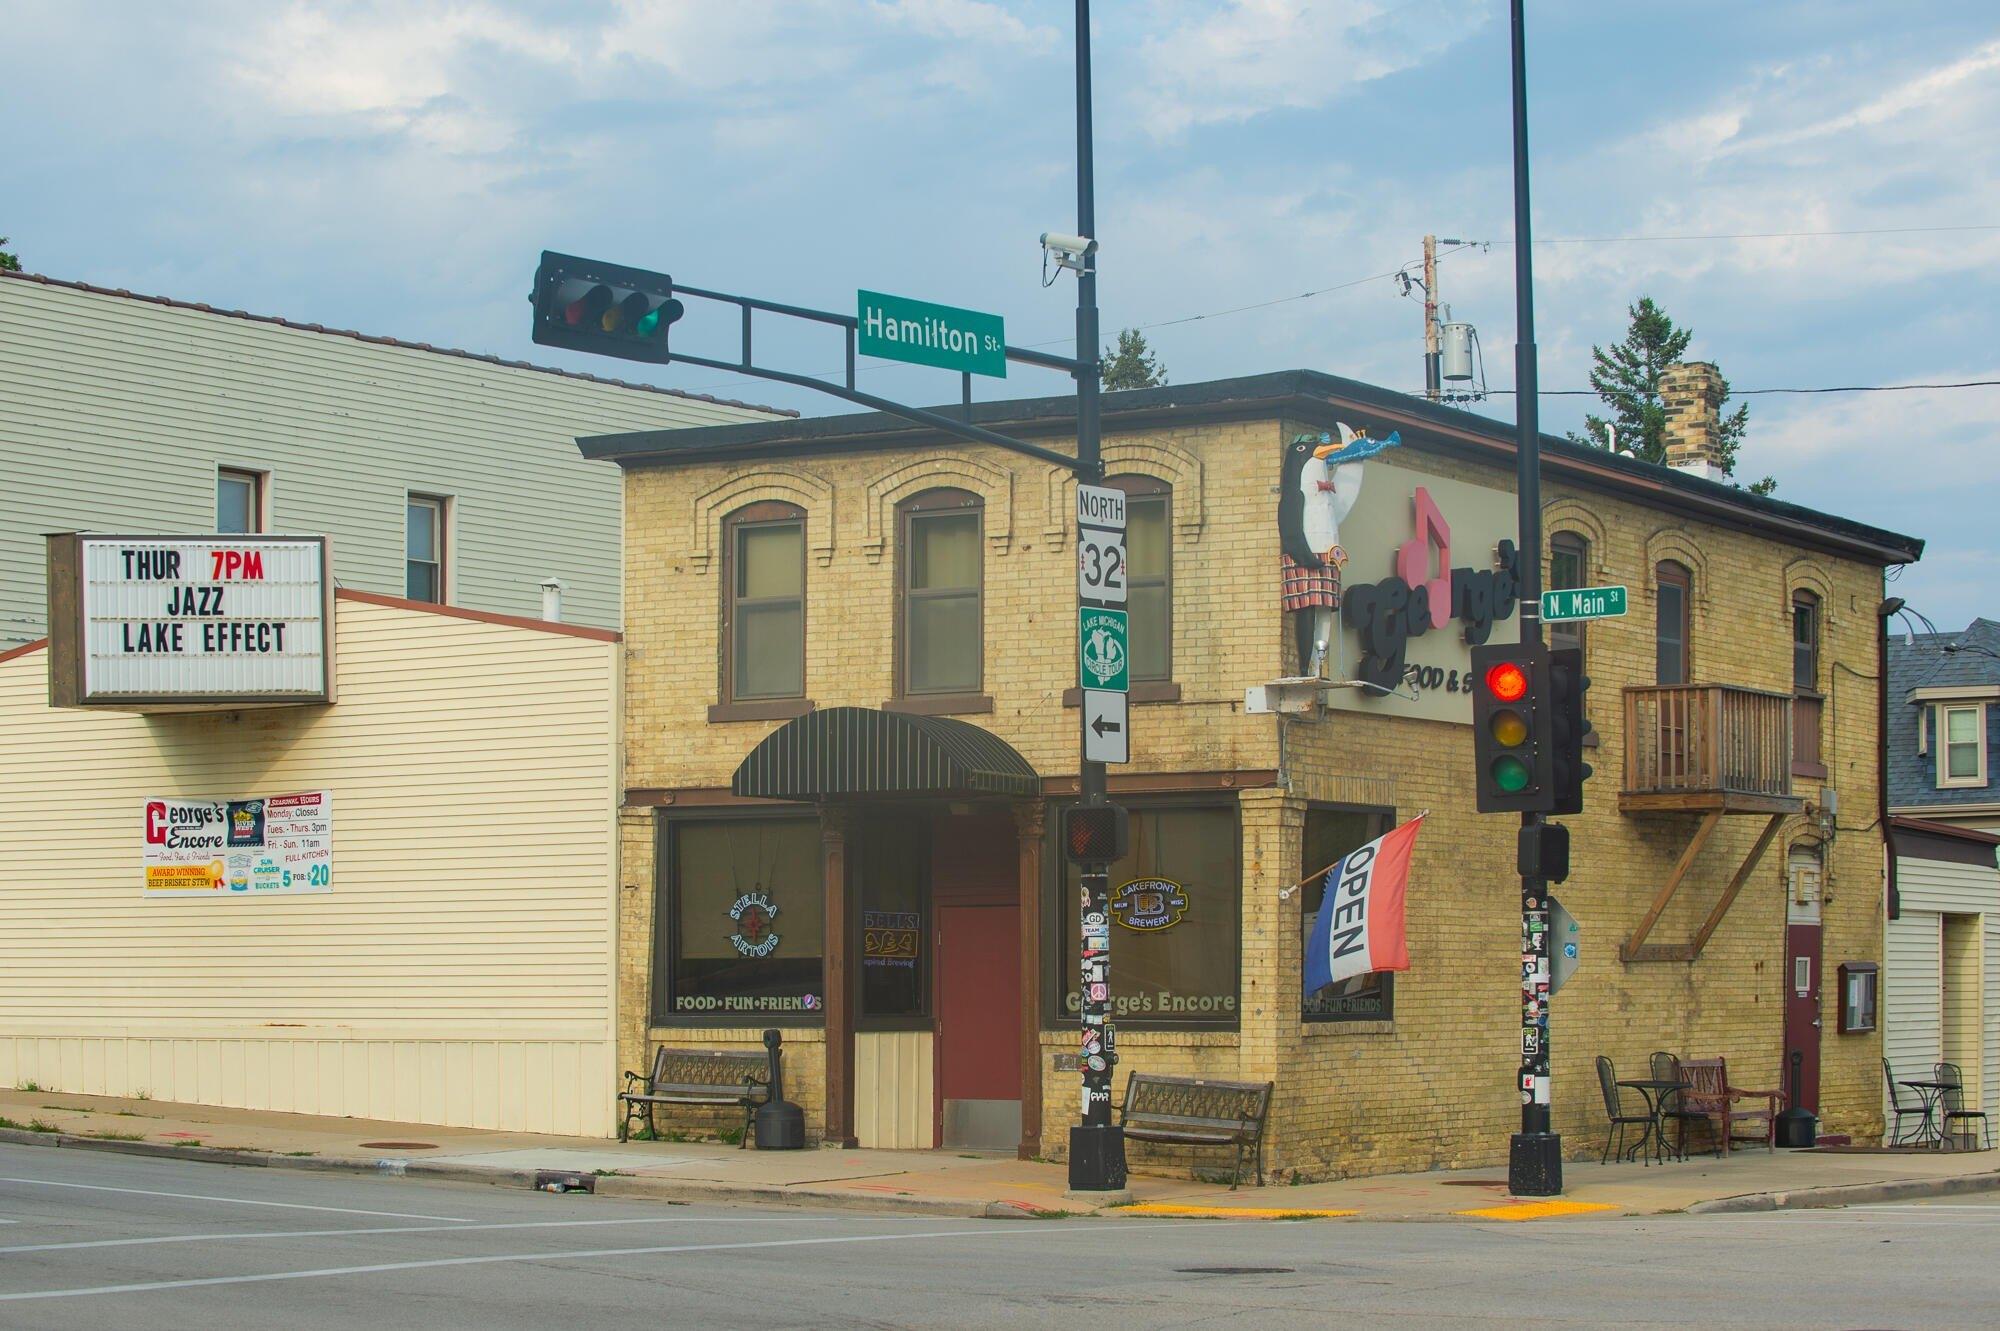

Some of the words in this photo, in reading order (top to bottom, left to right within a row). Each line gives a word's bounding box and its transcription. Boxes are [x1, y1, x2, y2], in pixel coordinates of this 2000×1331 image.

[867, 305, 978, 355] Hamilton
[1079, 490, 1124, 522] NORTH
[121, 549, 181, 580] THUR
[211, 551, 264, 580] 7PM
[1084, 542, 1122, 589] 32
[167, 586, 225, 616] JAZZ
[1550, 594, 1565, 617] N.
[1572, 592, 1605, 615] Main
[1610, 590, 1619, 603] St
[1082, 616, 1098, 632] LAKE
[1098, 615, 1125, 635] MICHIGAN
[123, 622, 184, 653] LAKE
[203, 622, 286, 653] EFFECT
[1086, 656, 1107, 676] CIRCLE
[1107, 658, 1123, 676] TOUR
[1446, 669, 1459, 692] &
[270, 797, 299, 807] SEASONAL
[300, 795, 320, 805] HOURS
[295, 807, 318, 817] Closed
[167, 826, 224, 849] Encore
[267, 824, 285, 834] Tues.
[290, 823, 310, 833] Thurs.
[311, 822, 327, 834] 3pm
[267, 840, 278, 849] Fri.
[283, 839, 298, 849] Sun.
[302, 839, 320, 848] 11am
[260, 858, 273, 866] SUN
[285, 854, 301, 863] FULL
[301, 849, 329, 861] KITCHEN
[152, 868, 175, 877] AWARD
[176, 867, 206, 876] WINNING
[253, 866, 280, 874] CRUISER
[282, 869, 291, 888] 5
[307, 863, 329, 886] $20
[148, 878, 164, 888] BEEF
[164, 878, 191, 887] BRISKET
[191, 878, 210, 887] STEW
[255, 882, 280, 890] BUCKETS
[1121, 881, 1176, 897] LAKEFRONT
[730, 892, 778, 920] STELLA
[1333, 846, 1375, 960] OPEN
[1088, 914, 1102, 923] GD
[1128, 914, 1170, 928] BREWERY
[731, 933, 779, 957] ARTOIS
[676, 996, 717, 1010] FOOD
[724, 996, 754, 1010] FUN
[760, 996, 822, 1010] FRIENS
[1065, 991, 1152, 1016] Grge's
[1158, 991, 1236, 1012] Encore
[1346, 998, 1383, 1012] FRIENDS
